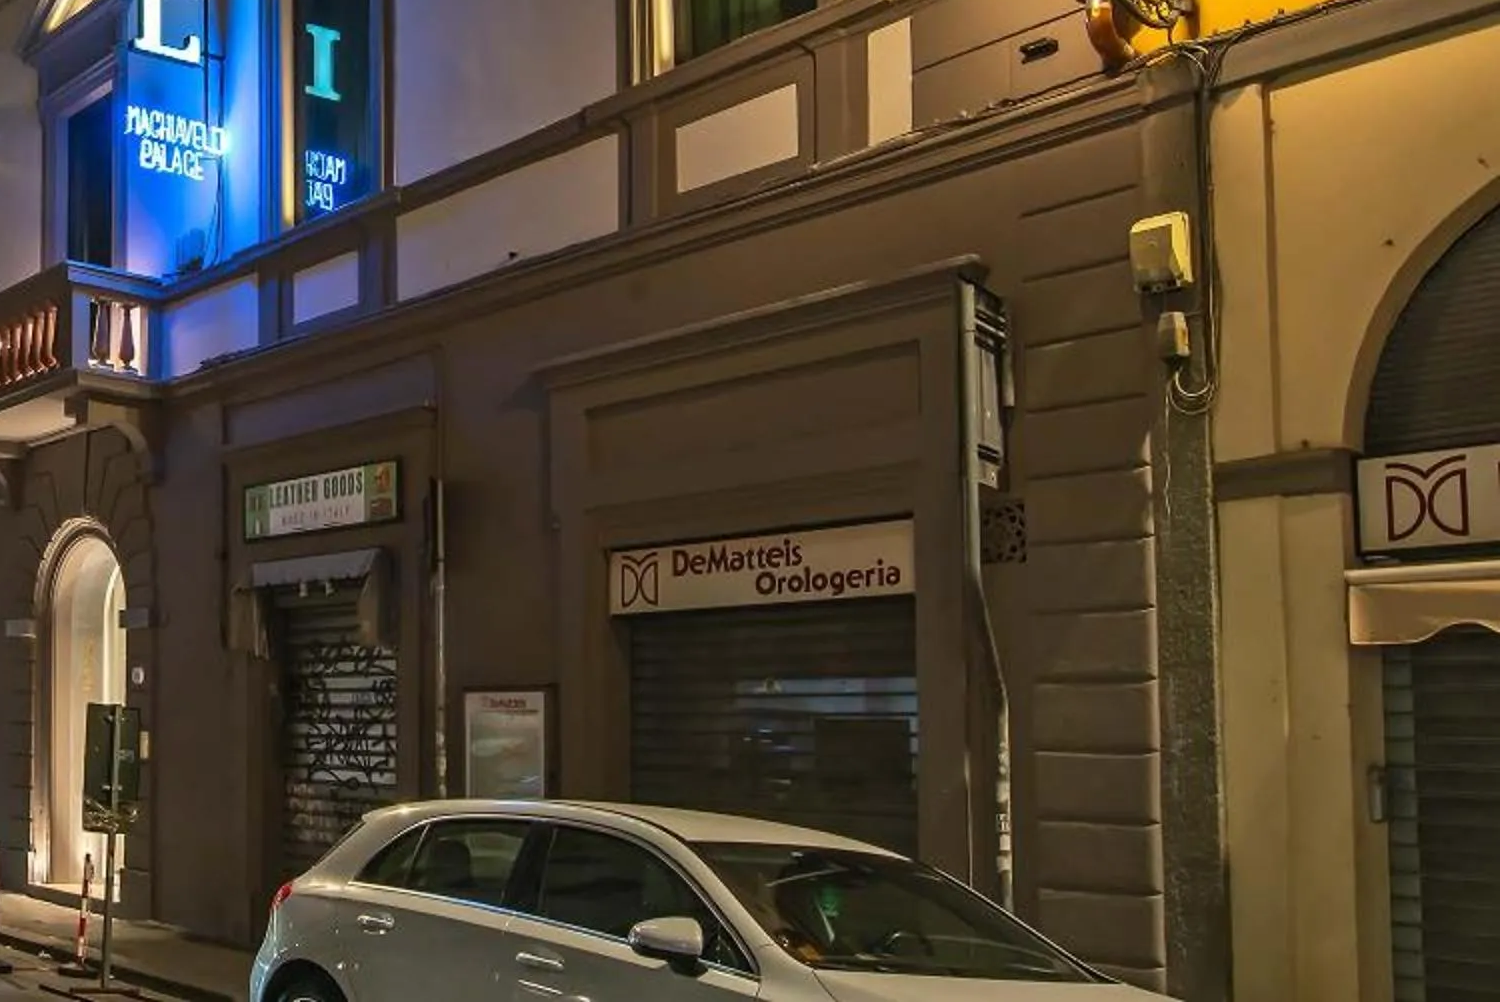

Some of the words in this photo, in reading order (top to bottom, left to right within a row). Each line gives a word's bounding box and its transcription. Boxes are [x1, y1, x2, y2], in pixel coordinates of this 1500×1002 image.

[324, 472, 363, 499] GOODS
[671, 539, 803, 577] DeMatteis
[755, 559, 901, 596] Orologeria
